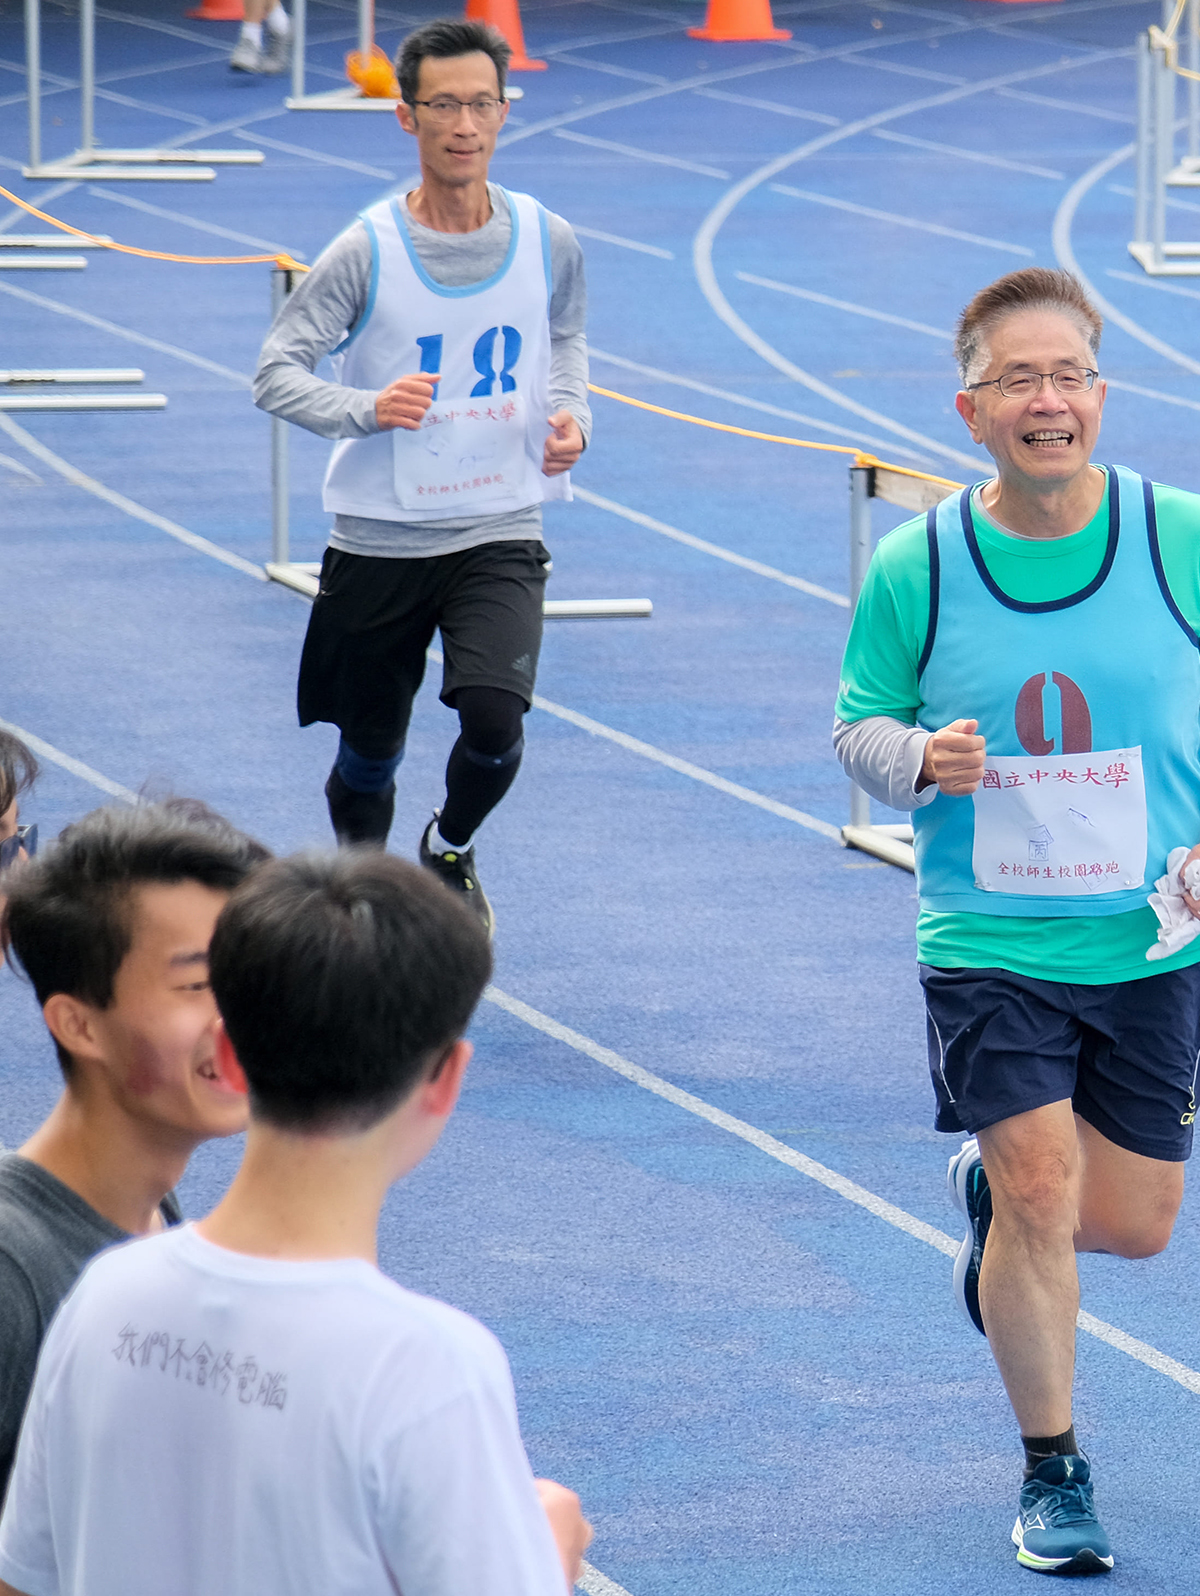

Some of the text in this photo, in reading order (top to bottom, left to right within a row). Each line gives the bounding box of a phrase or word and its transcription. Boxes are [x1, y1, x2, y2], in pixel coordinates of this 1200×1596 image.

[416, 325, 522, 402] 18
[423, 400, 517, 428] 立中央大學
[1015, 671, 1092, 756] 9
[982, 762, 1130, 790] 國立中央大學
[998, 861, 1120, 879] 全校師生校園路跑
[110, 1321, 288, 1412] 我們不會修電腦
